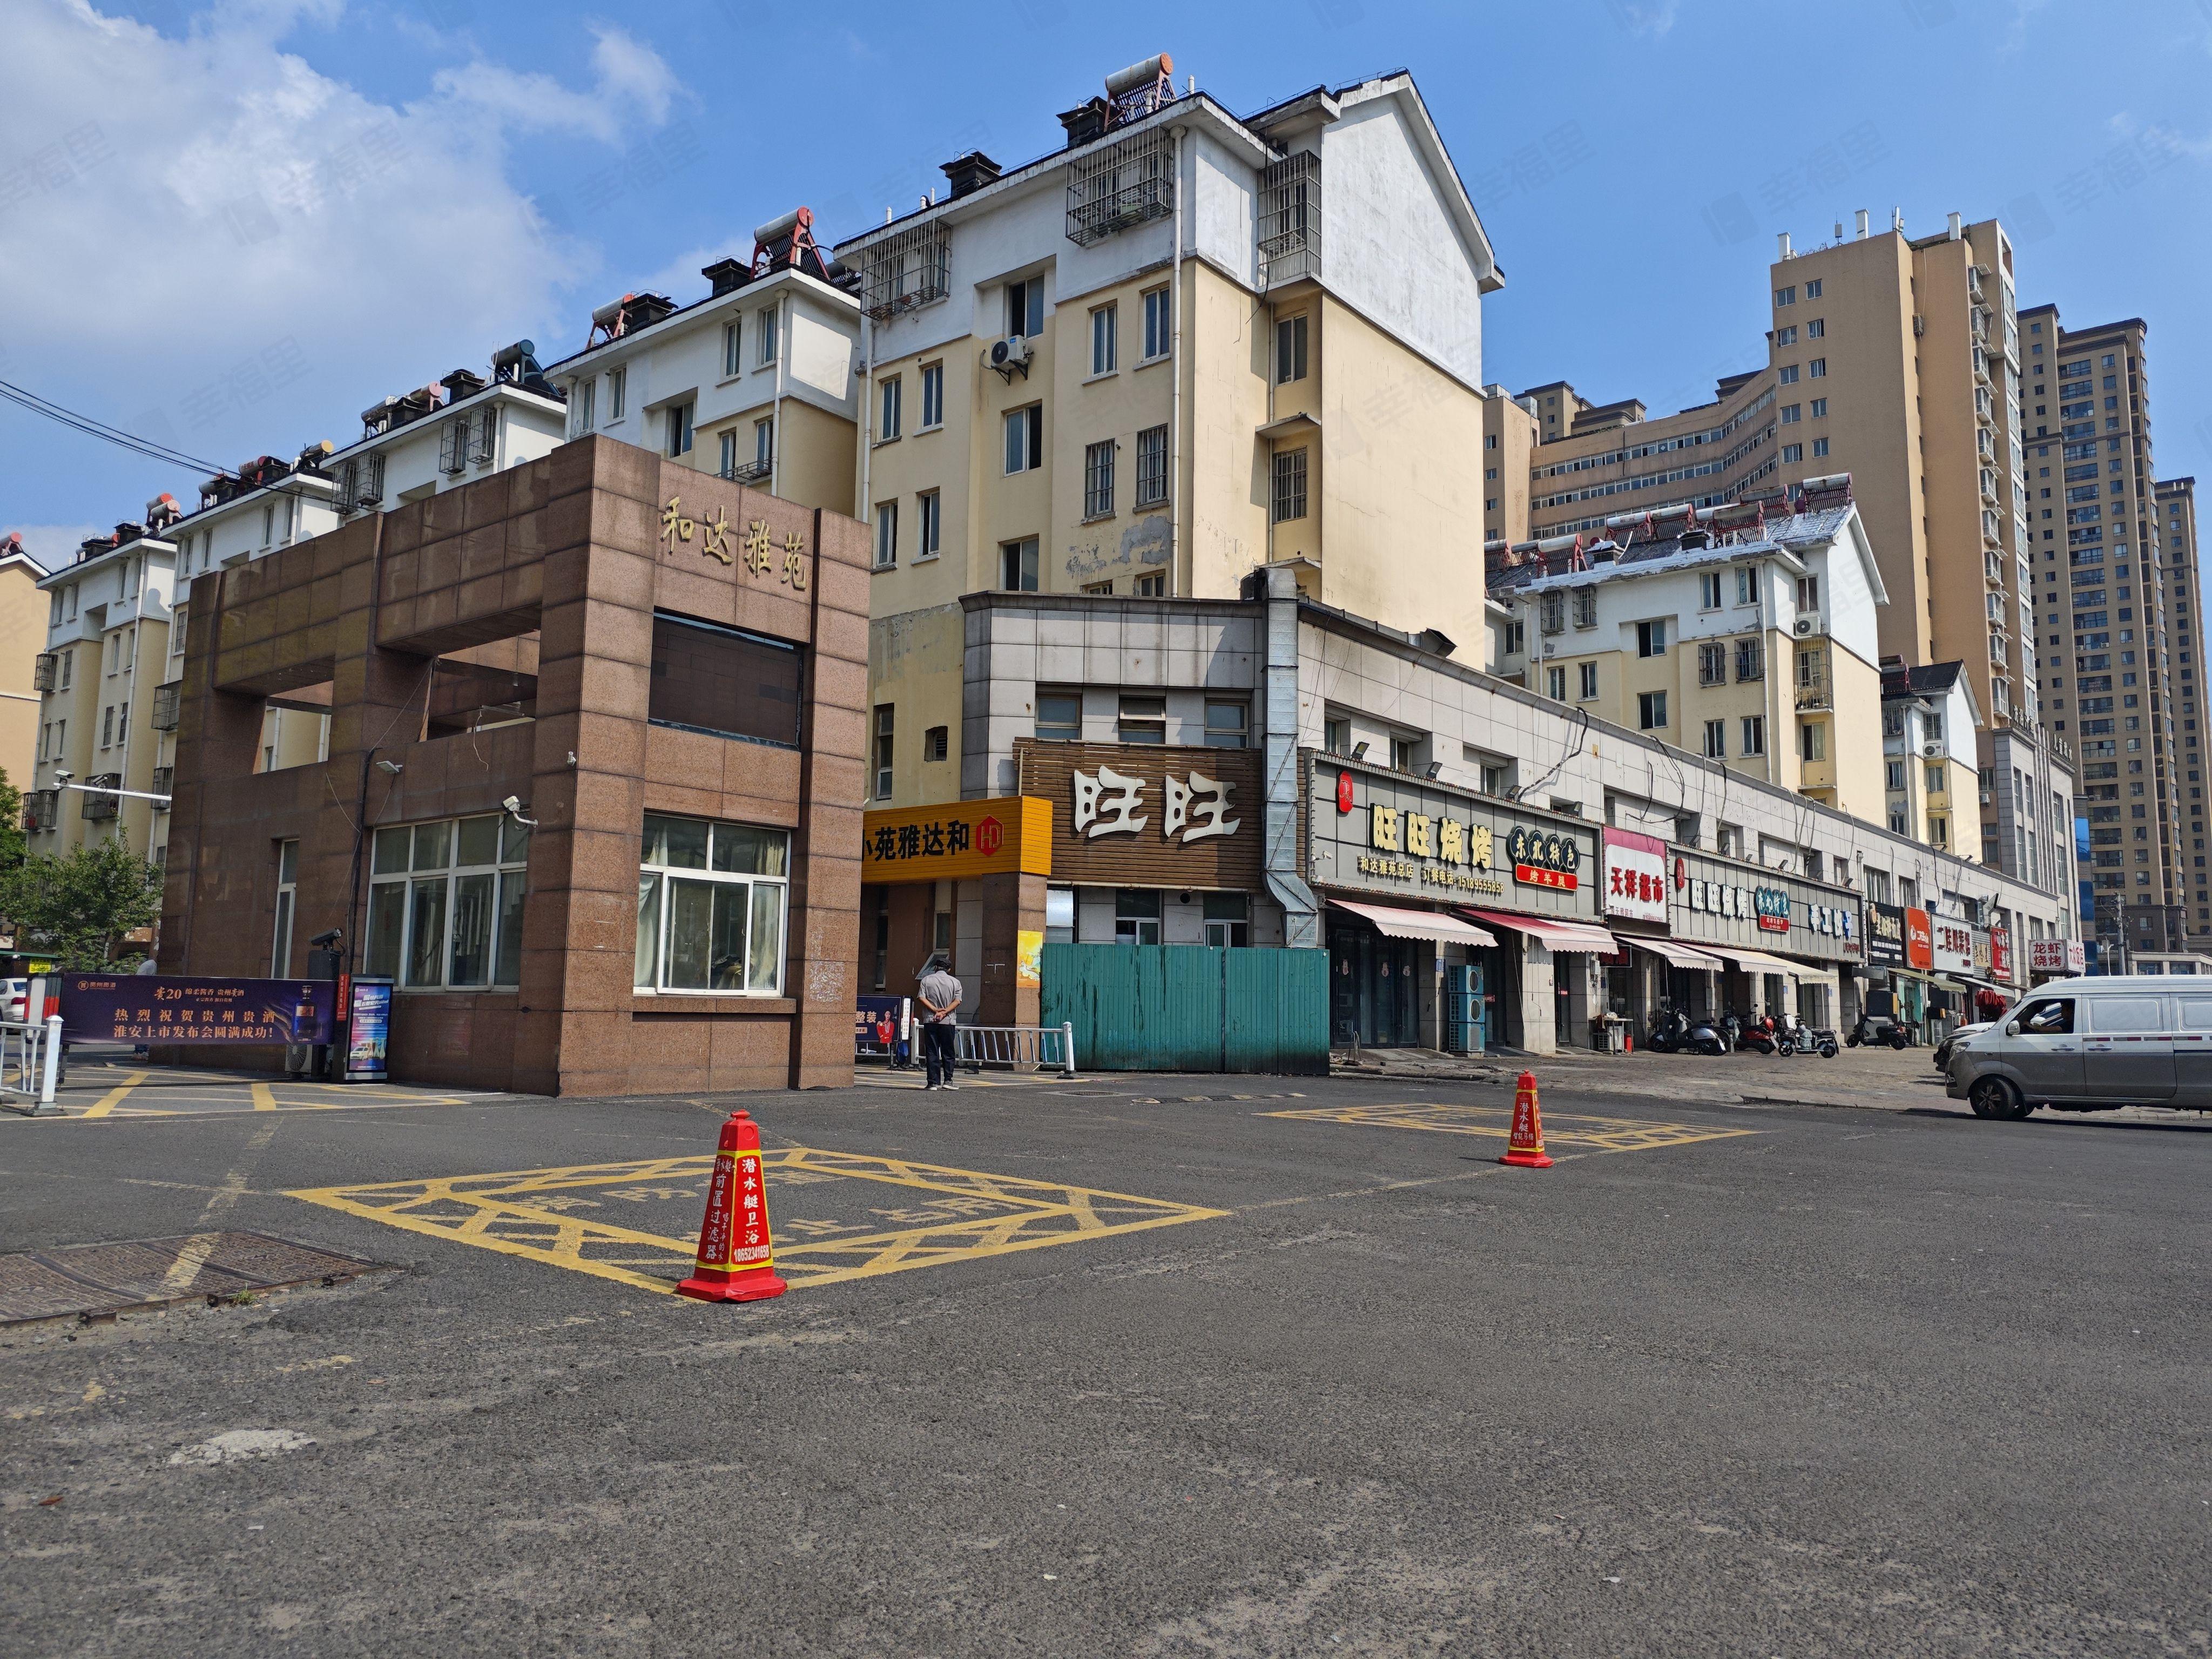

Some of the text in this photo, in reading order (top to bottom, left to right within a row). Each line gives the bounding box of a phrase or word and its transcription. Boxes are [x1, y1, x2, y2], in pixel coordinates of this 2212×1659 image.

[659, 496, 807, 590] 和达雅苑
[1074, 765, 1240, 842] 旺旺
[1372, 804, 1493, 869] 旺旺烧烤
[1516, 833, 1575, 869] 东北特色
[1360, 855, 1414, 879] 和达雅苑总店
[1611, 867, 1664, 903] 天祥超市
[1691, 879, 1748, 918] 旺旺烧烤
[2033, 942, 2061, 954] 龙虾
[2033, 955, 2062, 967] 烧烤
[114, 1008, 275, 1023] 热烈祝贺贵州贵酒
[1518, 1102, 1529, 1132] 潜水艇
[705, 1174, 727, 1260] 前置过滤器
[742, 1157, 760, 1245] 潜水艇卫浴
[733, 1244, 770, 1263] 18652341658
